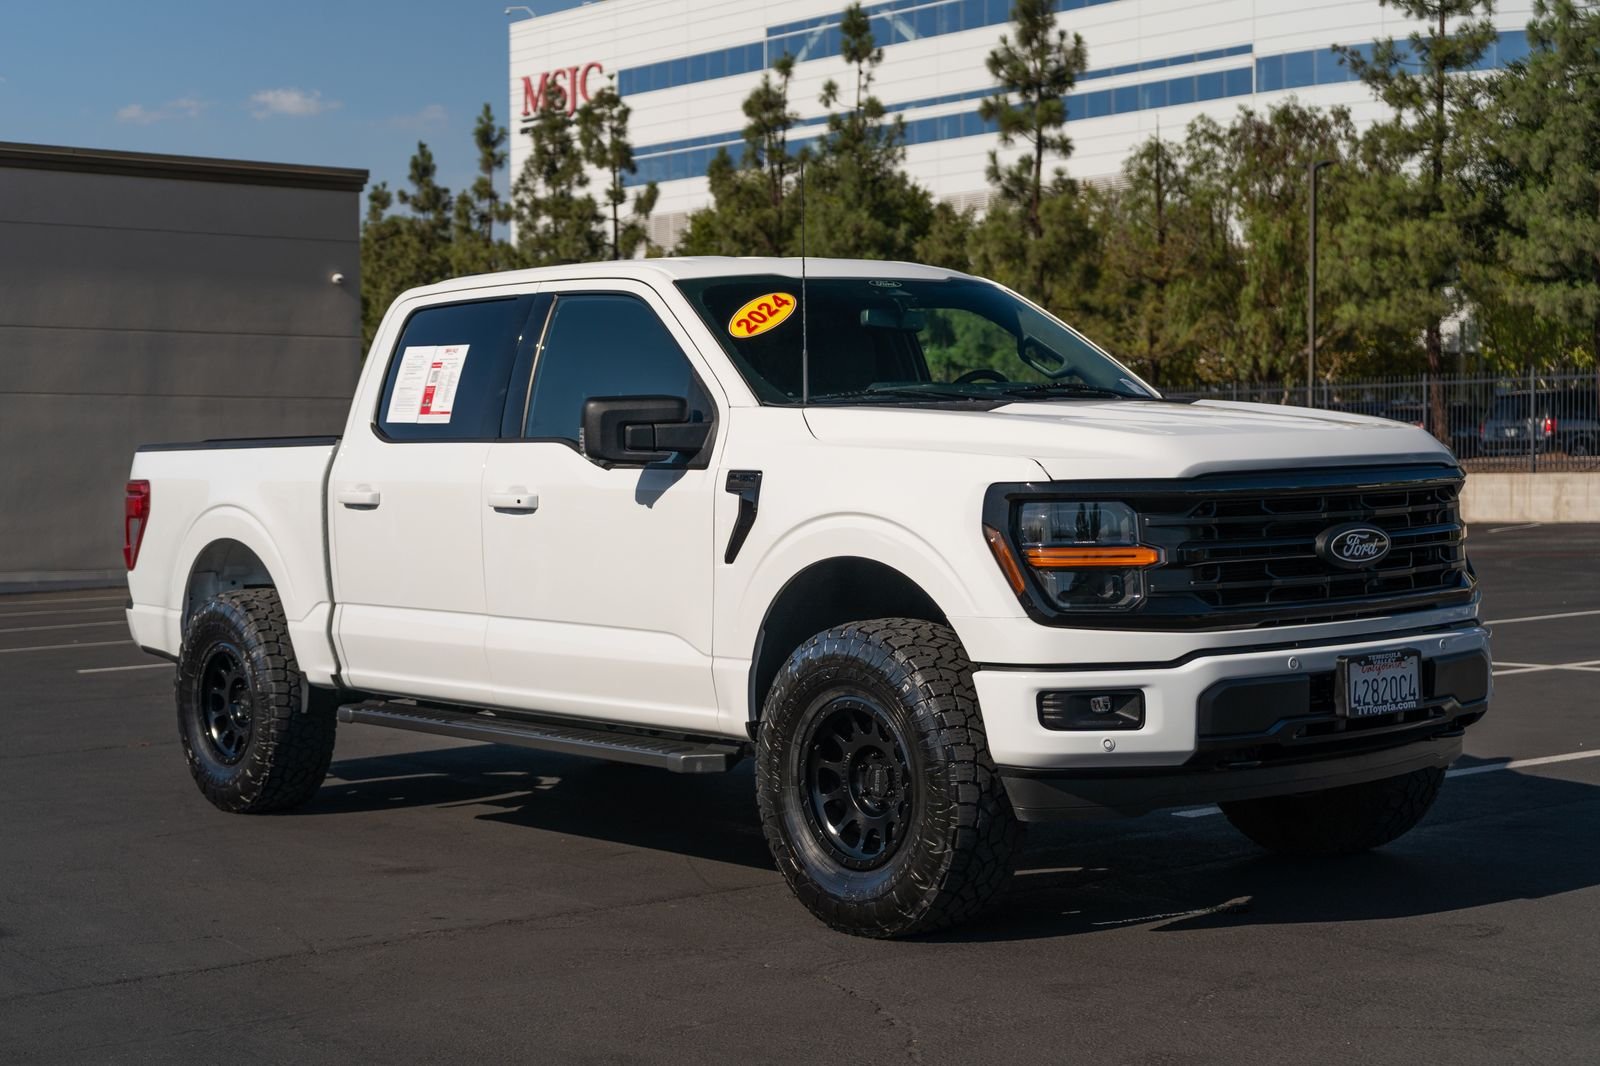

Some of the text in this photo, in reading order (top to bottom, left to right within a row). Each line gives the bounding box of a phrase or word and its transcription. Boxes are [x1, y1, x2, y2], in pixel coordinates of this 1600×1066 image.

[521, 62, 603, 117] MSJC
[736, 294, 790, 334] 2024
[1343, 533, 1378, 557] Ford
[1353, 673, 1417, 706] 42820C4
[1356, 700, 1417, 716] TVToyota.com
